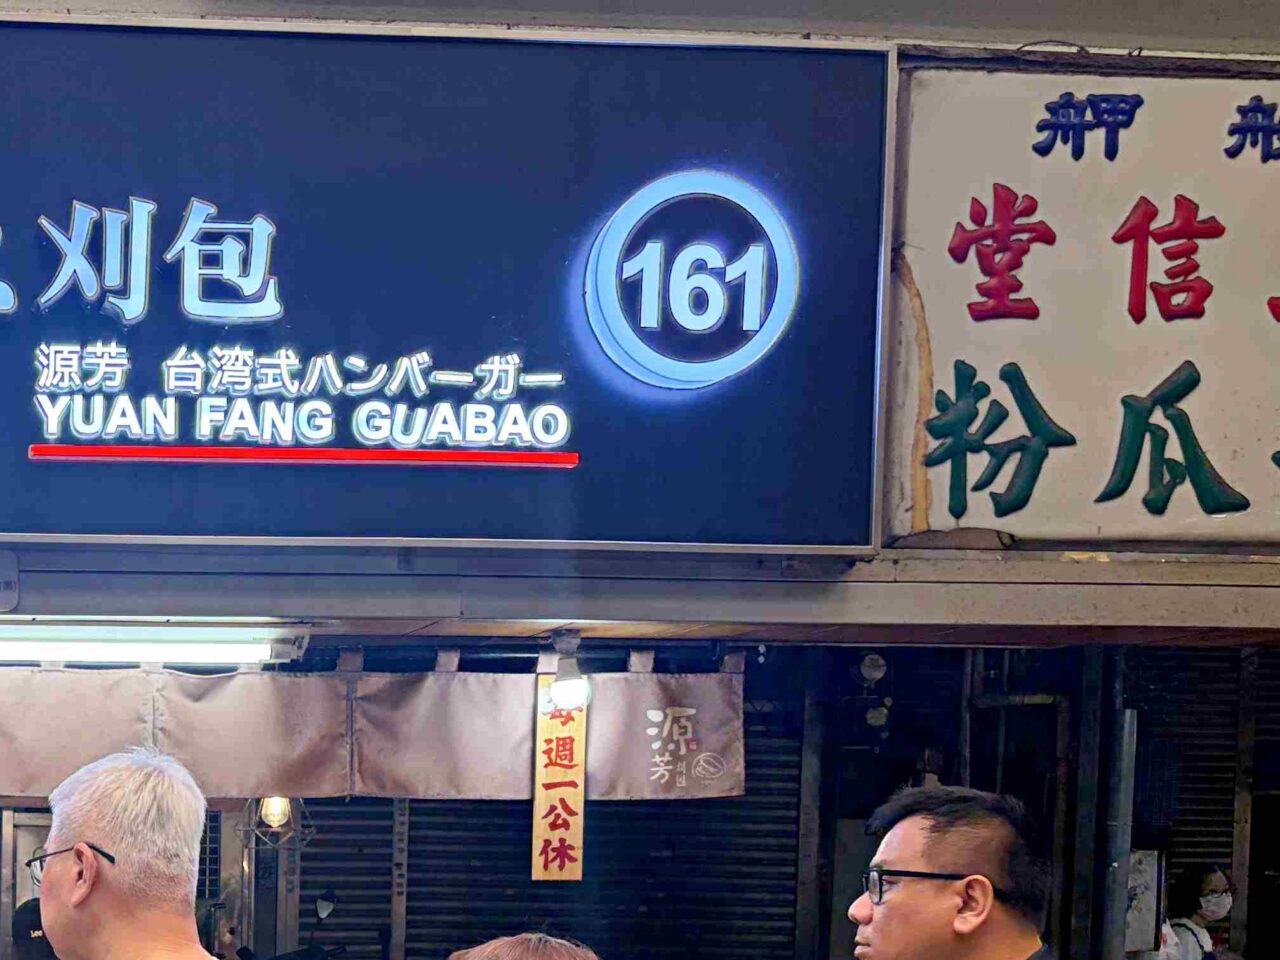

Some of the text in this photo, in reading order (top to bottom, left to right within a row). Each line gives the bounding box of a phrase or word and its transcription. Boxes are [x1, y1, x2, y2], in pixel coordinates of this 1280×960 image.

[35, 197, 283, 321] 刈包
[622, 240, 767, 332] 161
[34, 342, 564, 398] 源芳 台湾式ハンバーガー
[35, 394, 571, 446] YUAN FANG GUABAO
[539, 697, 580, 872] 每週一公休
[646, 706, 697, 785] 源芳
